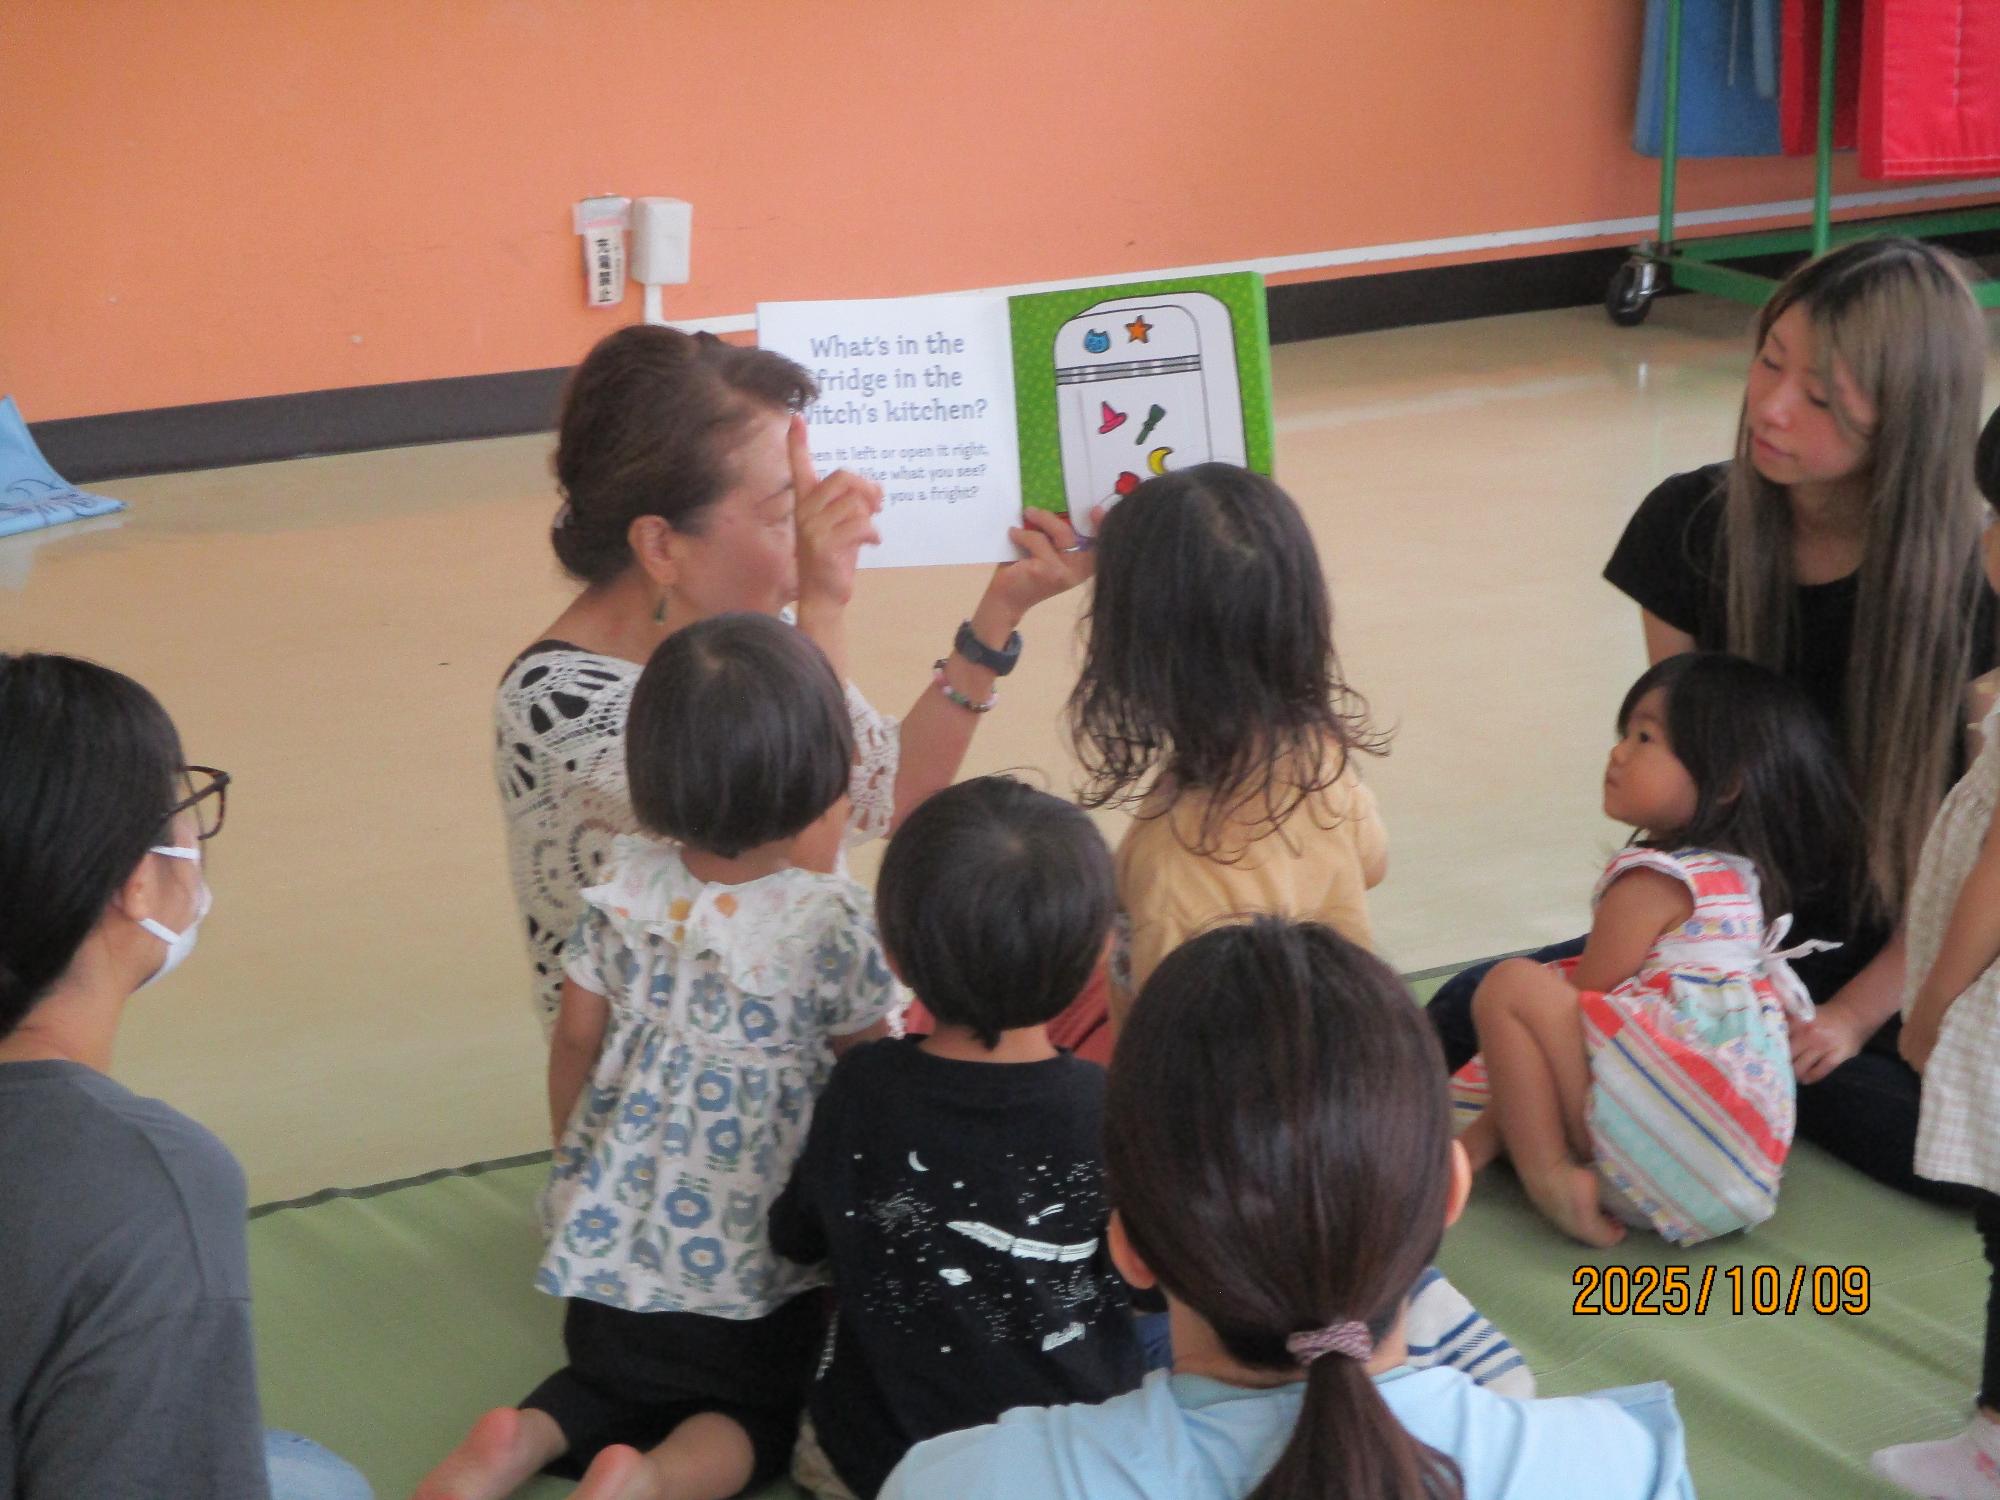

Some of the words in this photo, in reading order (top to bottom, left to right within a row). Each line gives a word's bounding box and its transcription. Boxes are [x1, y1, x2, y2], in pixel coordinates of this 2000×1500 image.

[809, 335, 890, 358] What's
[896, 335, 919, 356] in
[925, 331, 965, 355] the
[816, 368, 888, 397] fridge
[894, 368, 917, 389] in
[923, 365, 963, 388] the
[884, 398, 989, 422] kitchen?
[835, 449, 848, 460] it
[851, 446, 877, 460] left
[880, 448, 896, 459] or
[899, 447, 935, 462] open
[937, 444, 950, 457] it
[890, 465, 926, 480] what
[928, 467, 954, 482] you
[956, 463, 988, 477] see?
[889, 490, 914, 506] you
[917, 490, 927, 501] a
[930, 485, 980, 504] fright?
